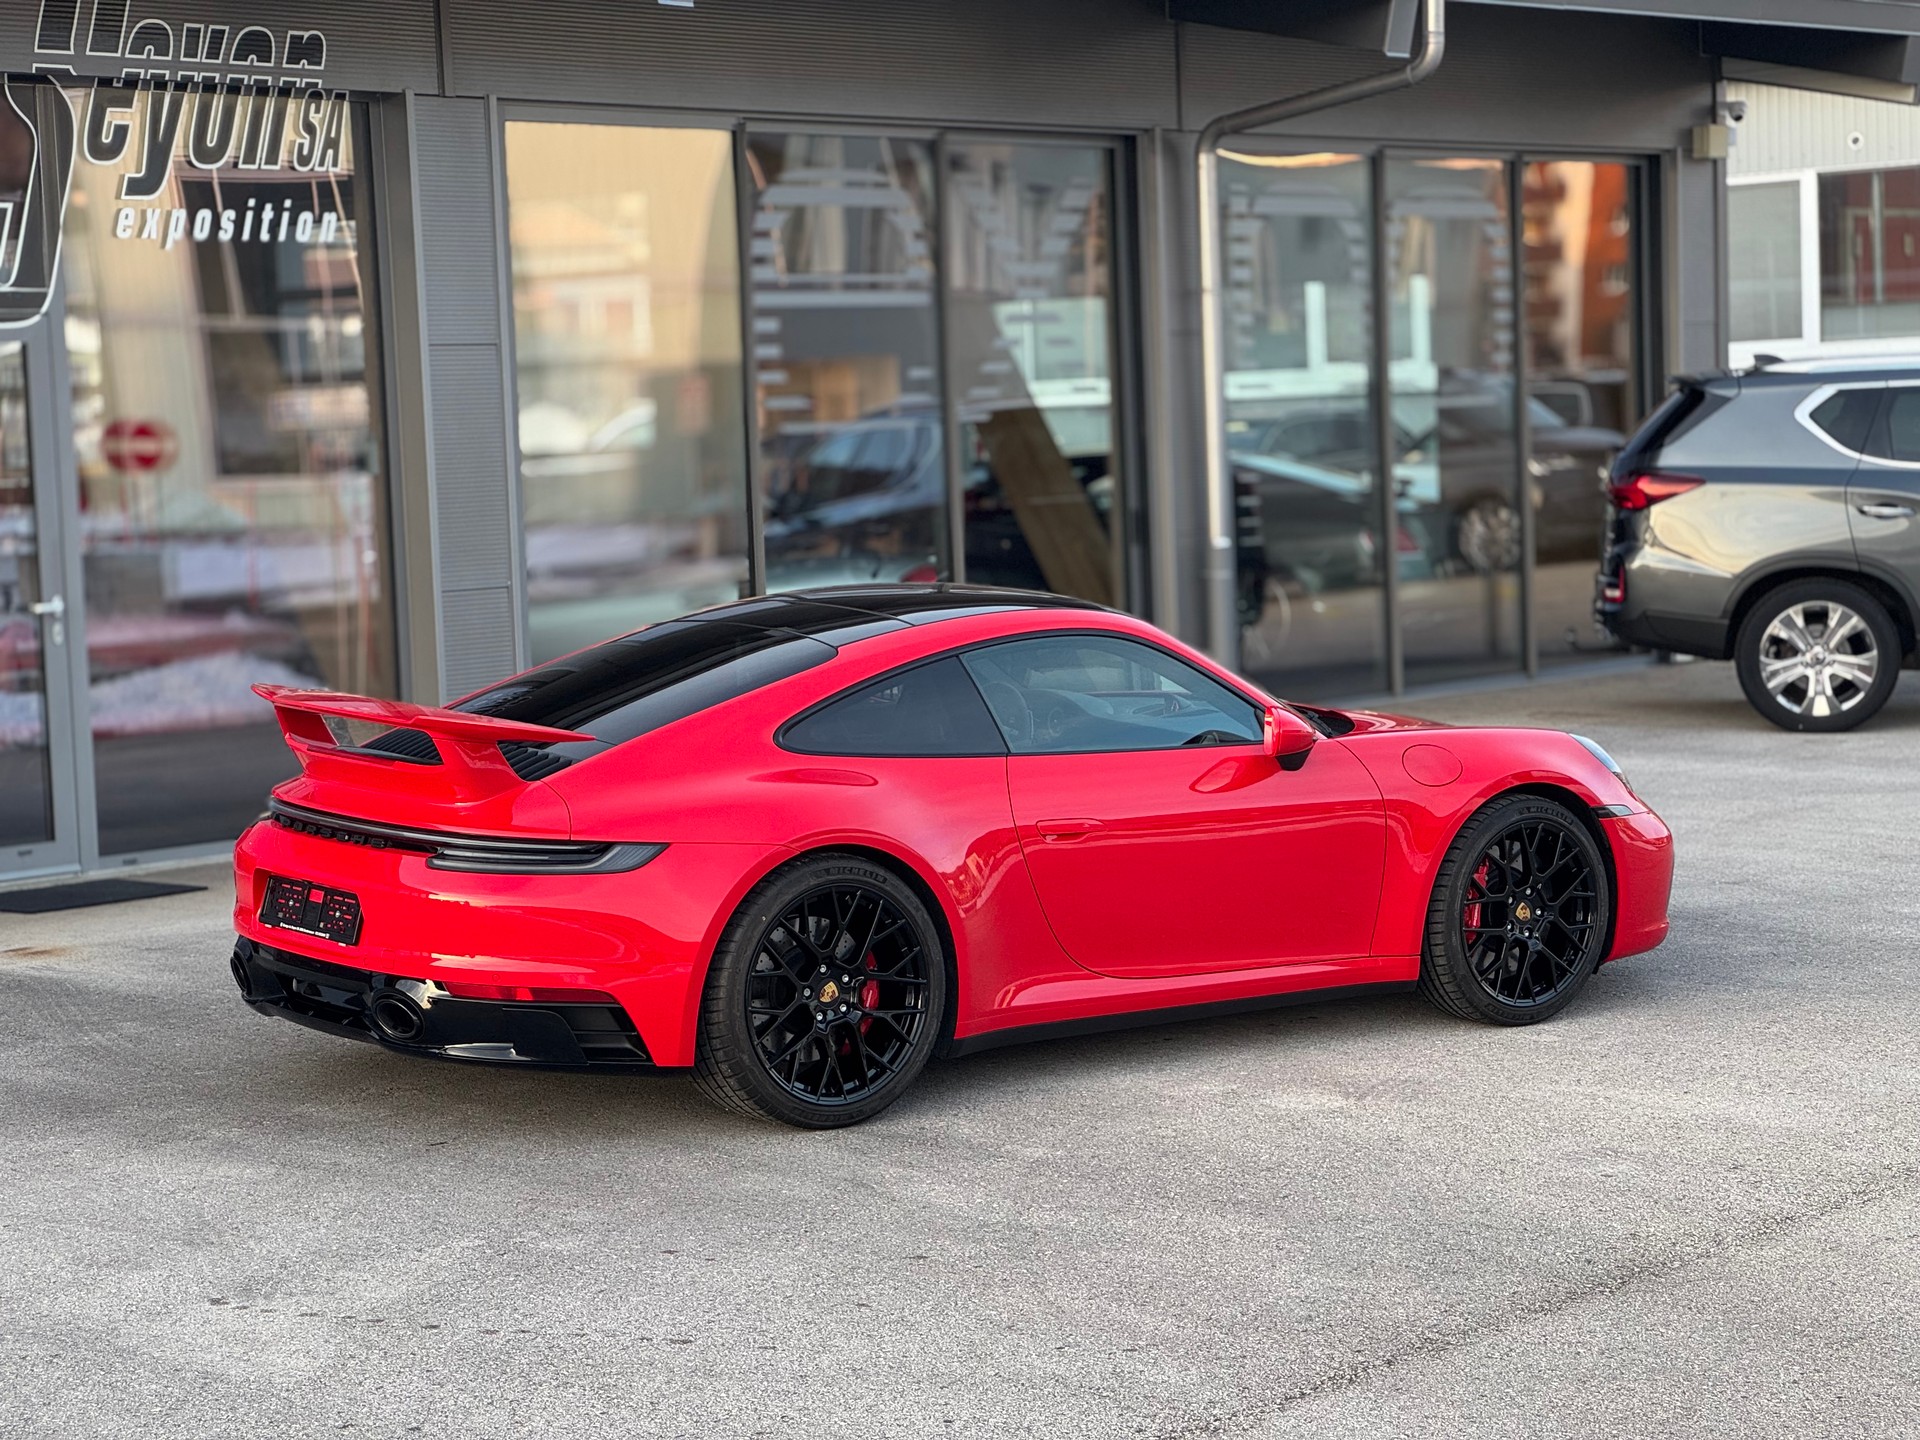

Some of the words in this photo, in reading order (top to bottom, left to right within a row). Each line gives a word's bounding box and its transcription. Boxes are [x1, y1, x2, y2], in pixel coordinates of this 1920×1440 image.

[292, 88, 349, 172] SA
[115, 198, 340, 250] exposition
[280, 816, 386, 848] PORSCHE
[830, 867, 884, 883] MICHELIN
